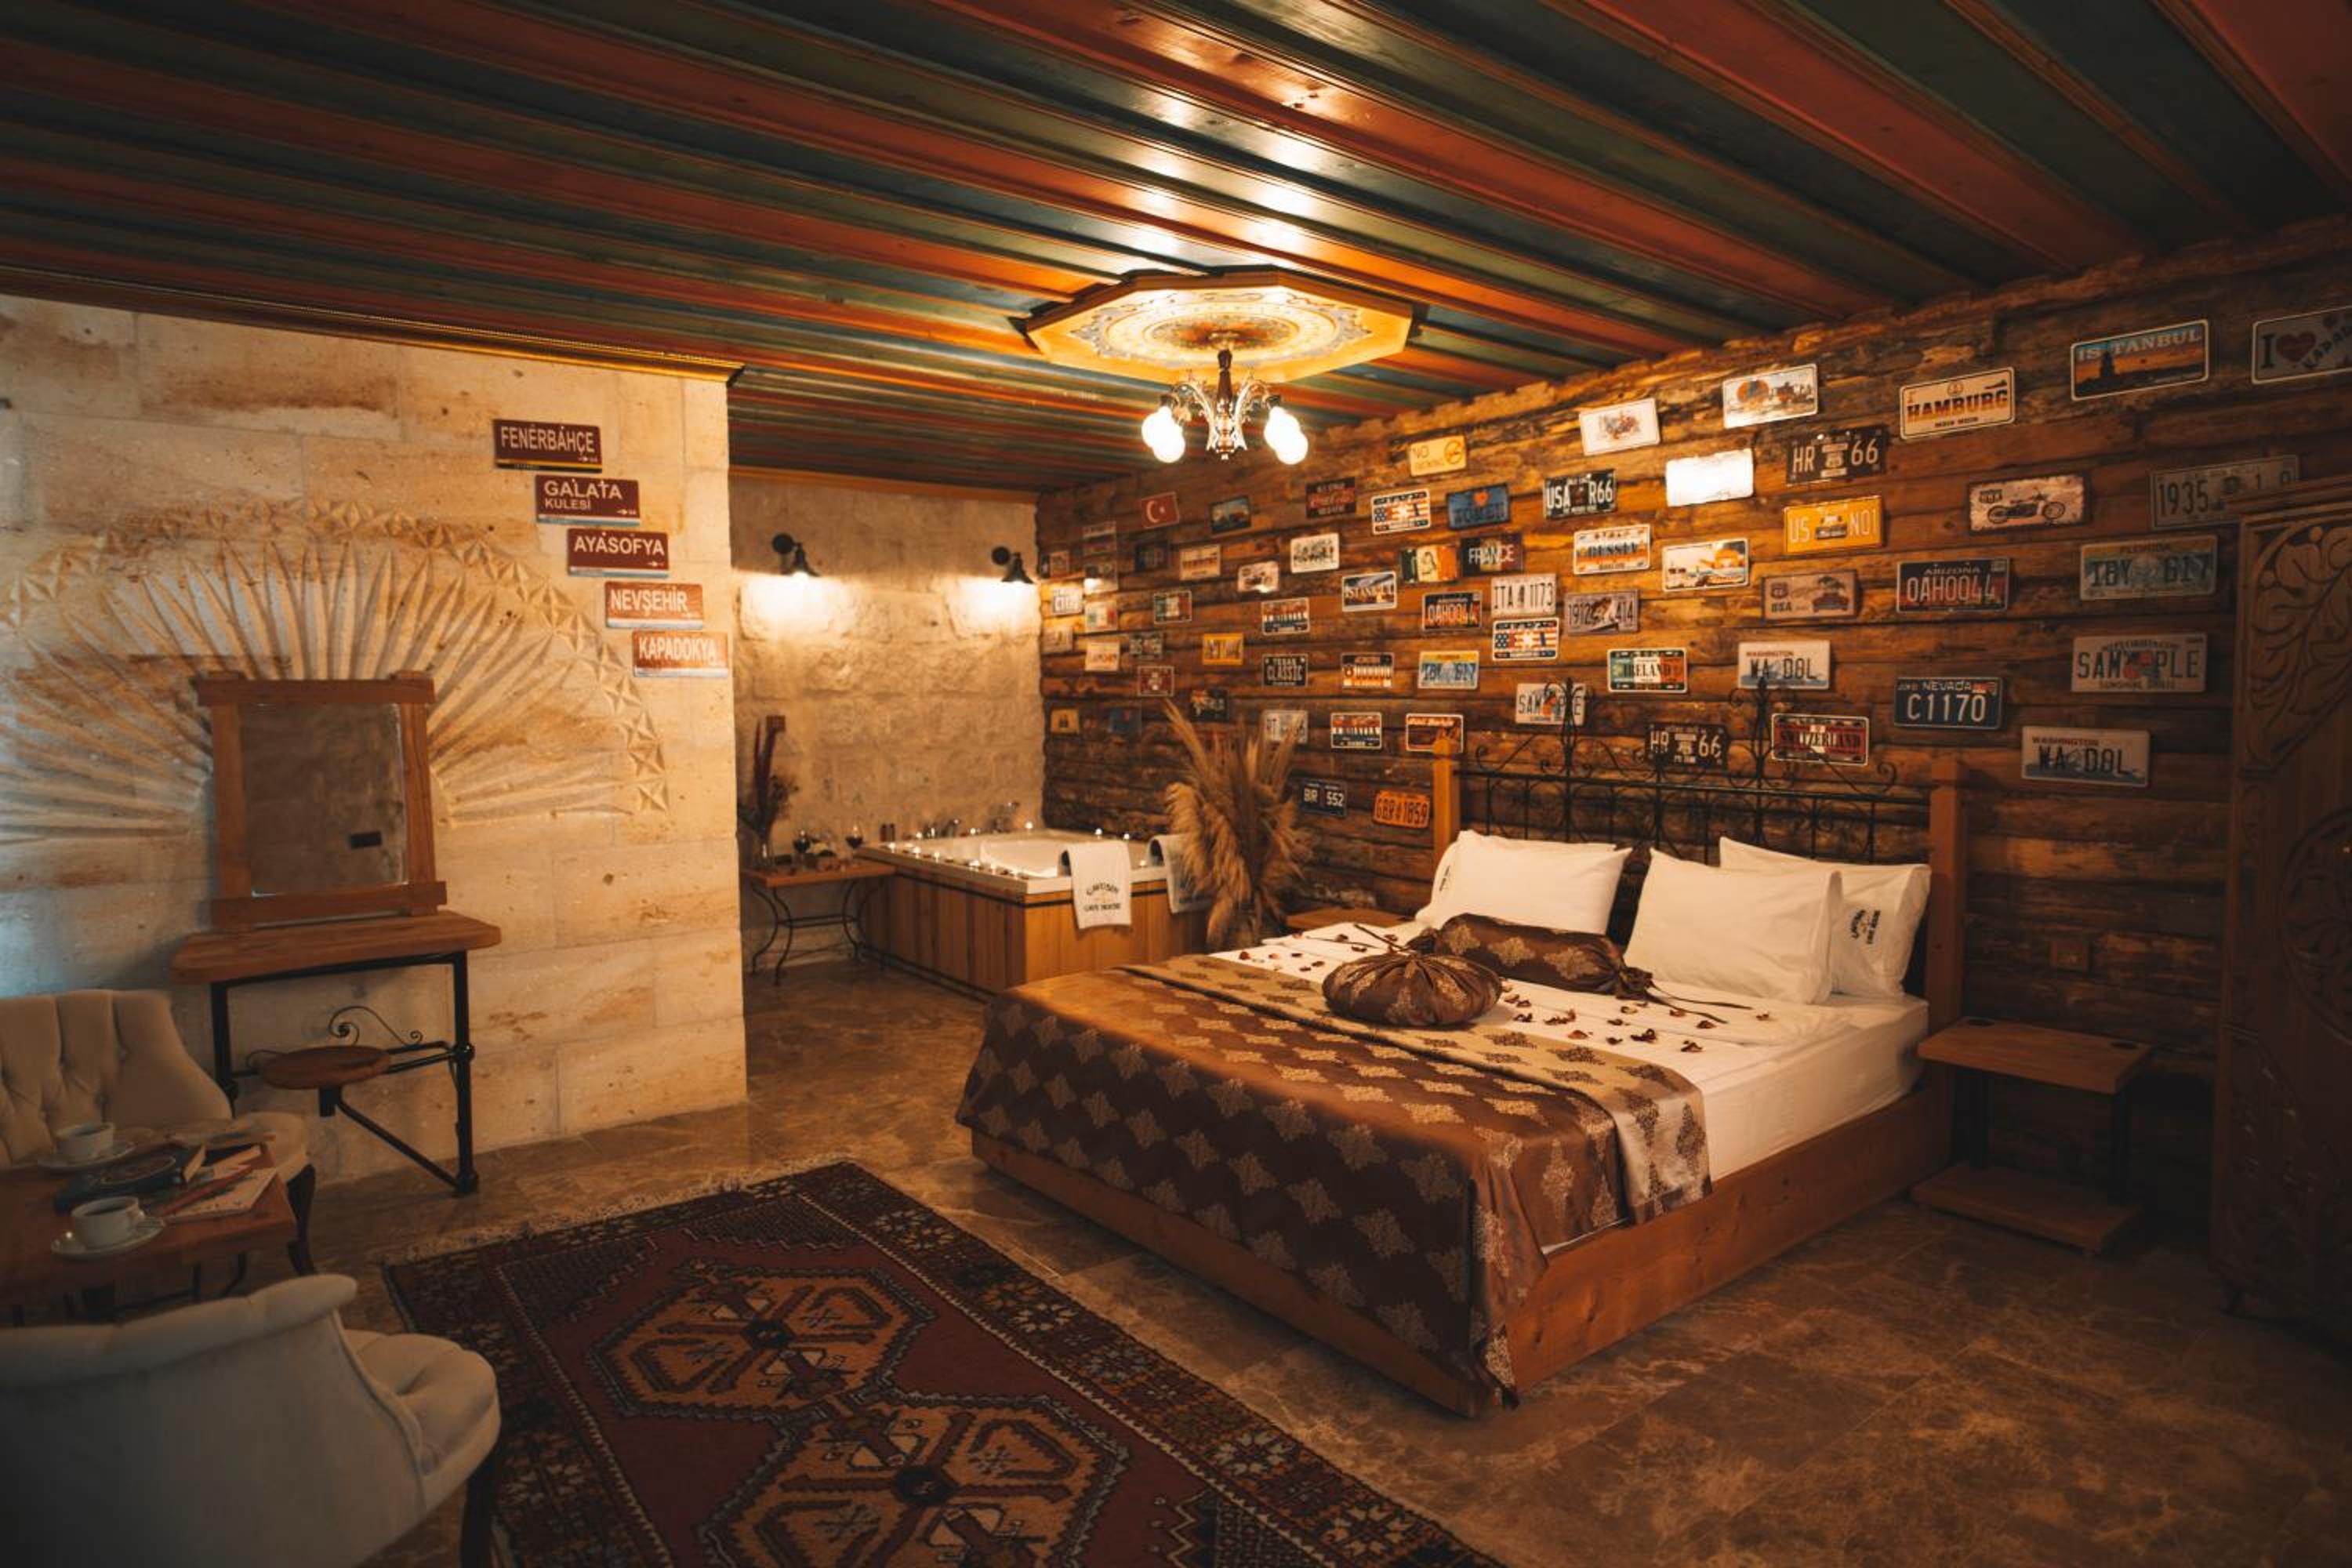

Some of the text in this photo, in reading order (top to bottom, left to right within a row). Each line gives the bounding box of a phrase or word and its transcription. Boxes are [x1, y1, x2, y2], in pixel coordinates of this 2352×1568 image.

[2260, 334, 2275, 369] I
[1907, 390, 2008, 421] HAMBURG
[500, 426, 595, 453] FENERBAHÇE
[1793, 439, 1878, 473] HR 66
[545, 481, 622, 499] GALATA
[1546, 479, 1613, 509] USA R66
[2158, 481, 2209, 517] 1935
[1789, 517, 1810, 543] US
[574, 536, 665, 555] AYASOFYA
[1468, 544, 1515, 564] FRANCE
[1923, 565, 1981, 576] ARIZONA
[610, 586, 688, 615] NEVŞEHİR
[639, 636, 717, 660] KAPADOKYA
[1267, 666, 1303, 681] CLASSIC
[1623, 663, 1671, 677] IRELAND
[1922, 681, 1971, 691] NEVADA
[1907, 694, 1986, 721] C1170
[1699, 735, 1722, 758] 66
